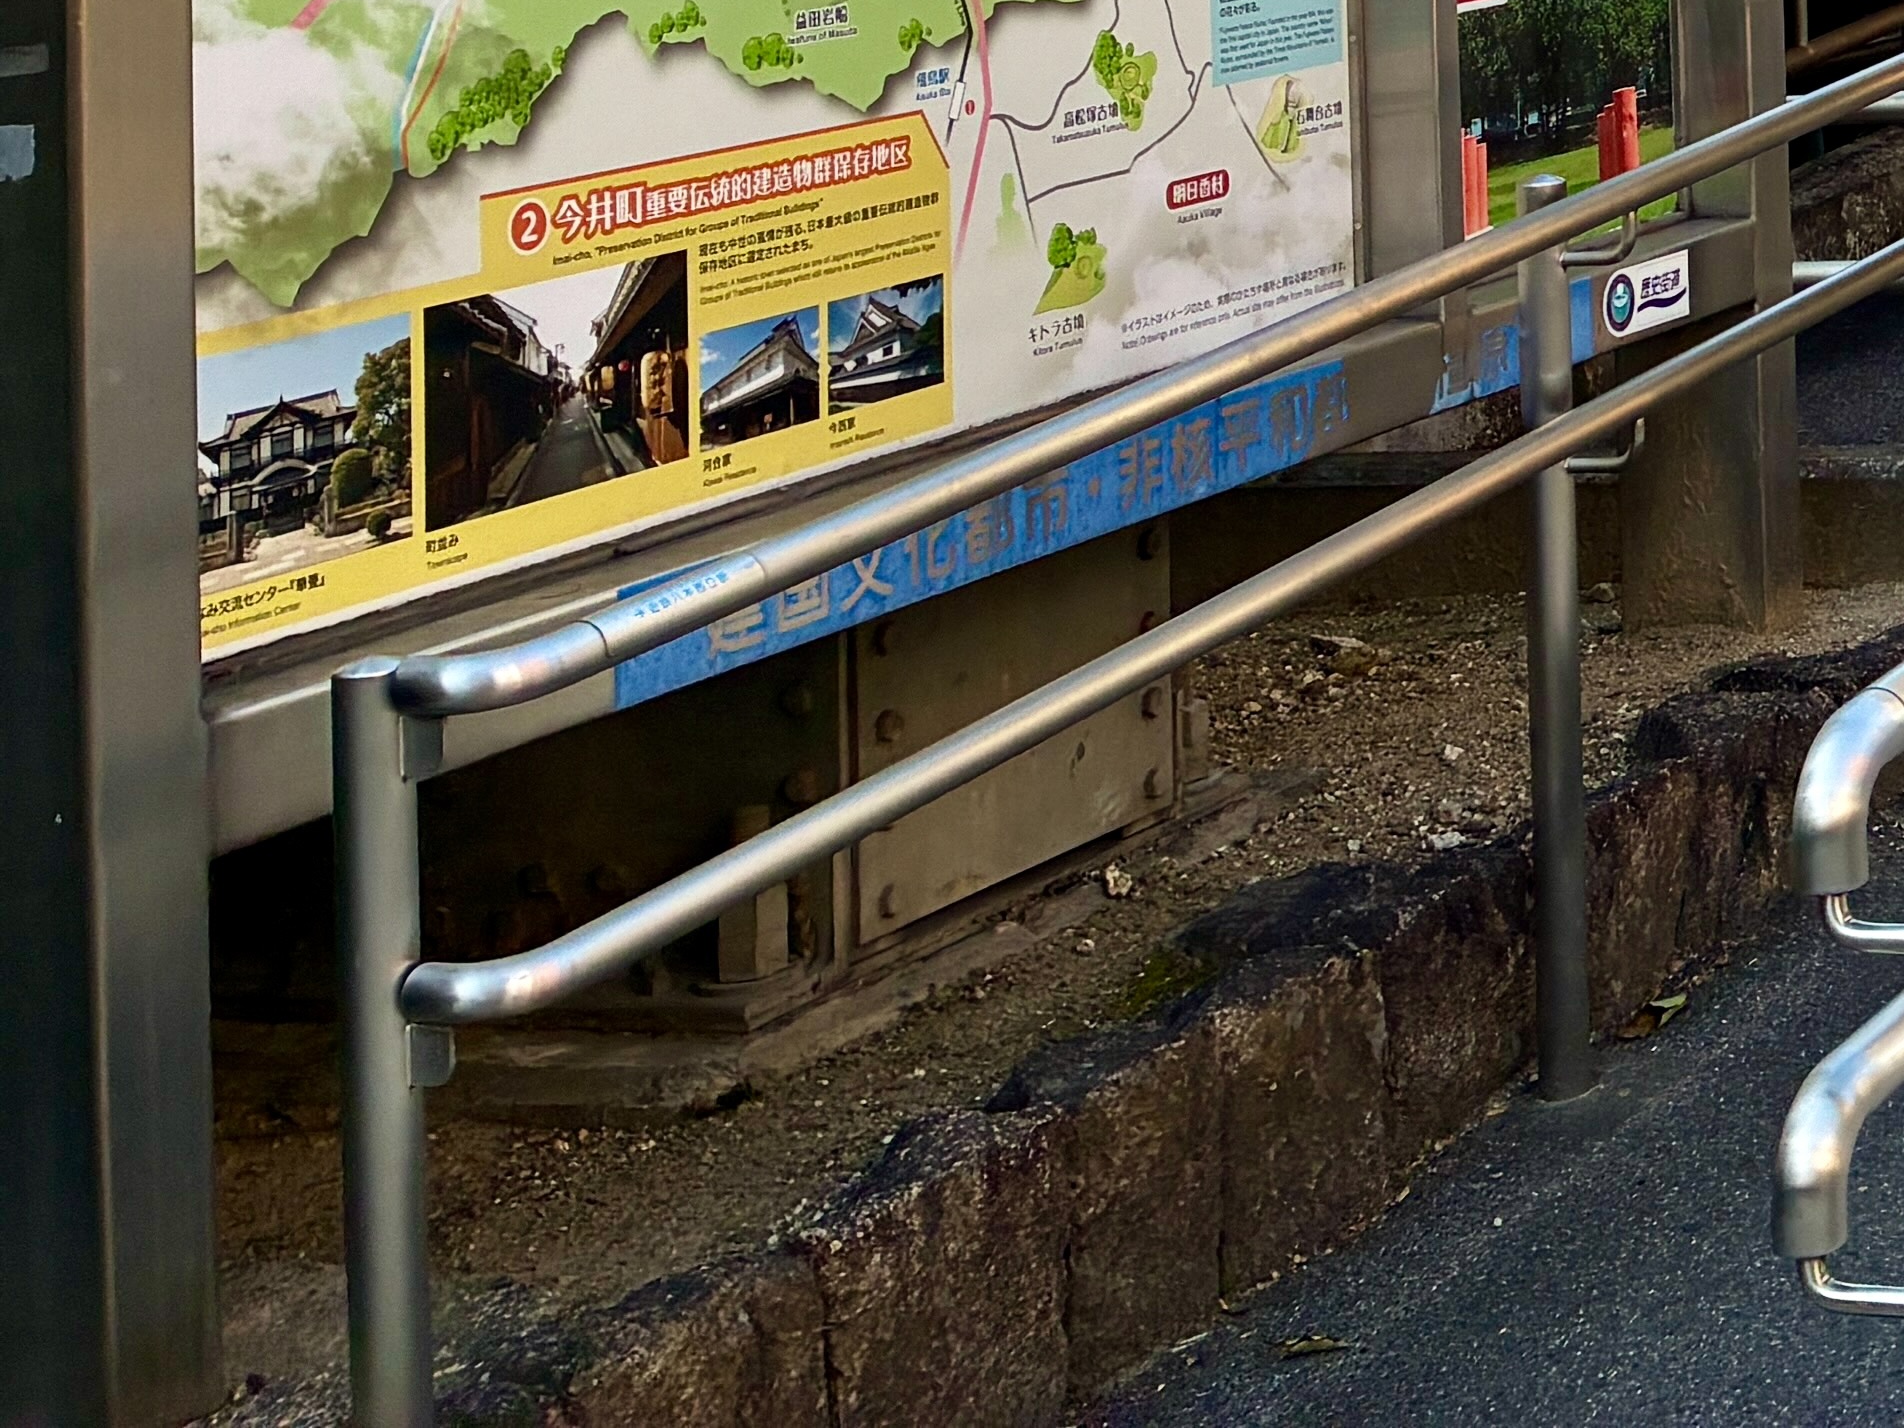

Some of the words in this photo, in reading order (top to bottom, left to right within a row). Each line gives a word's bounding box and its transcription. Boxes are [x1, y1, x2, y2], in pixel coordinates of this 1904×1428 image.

[796, 5, 848, 30] 益田岩船
[1064, 101, 1119, 128] 高松塚古墳
[554, 140, 910, 240] 今井町重要伝統的建造物群保存地区
[1172, 175, 1224, 204] 明日香村
[520, 213, 538, 245] 2
[1028, 314, 1086, 343] キトラ古墳
